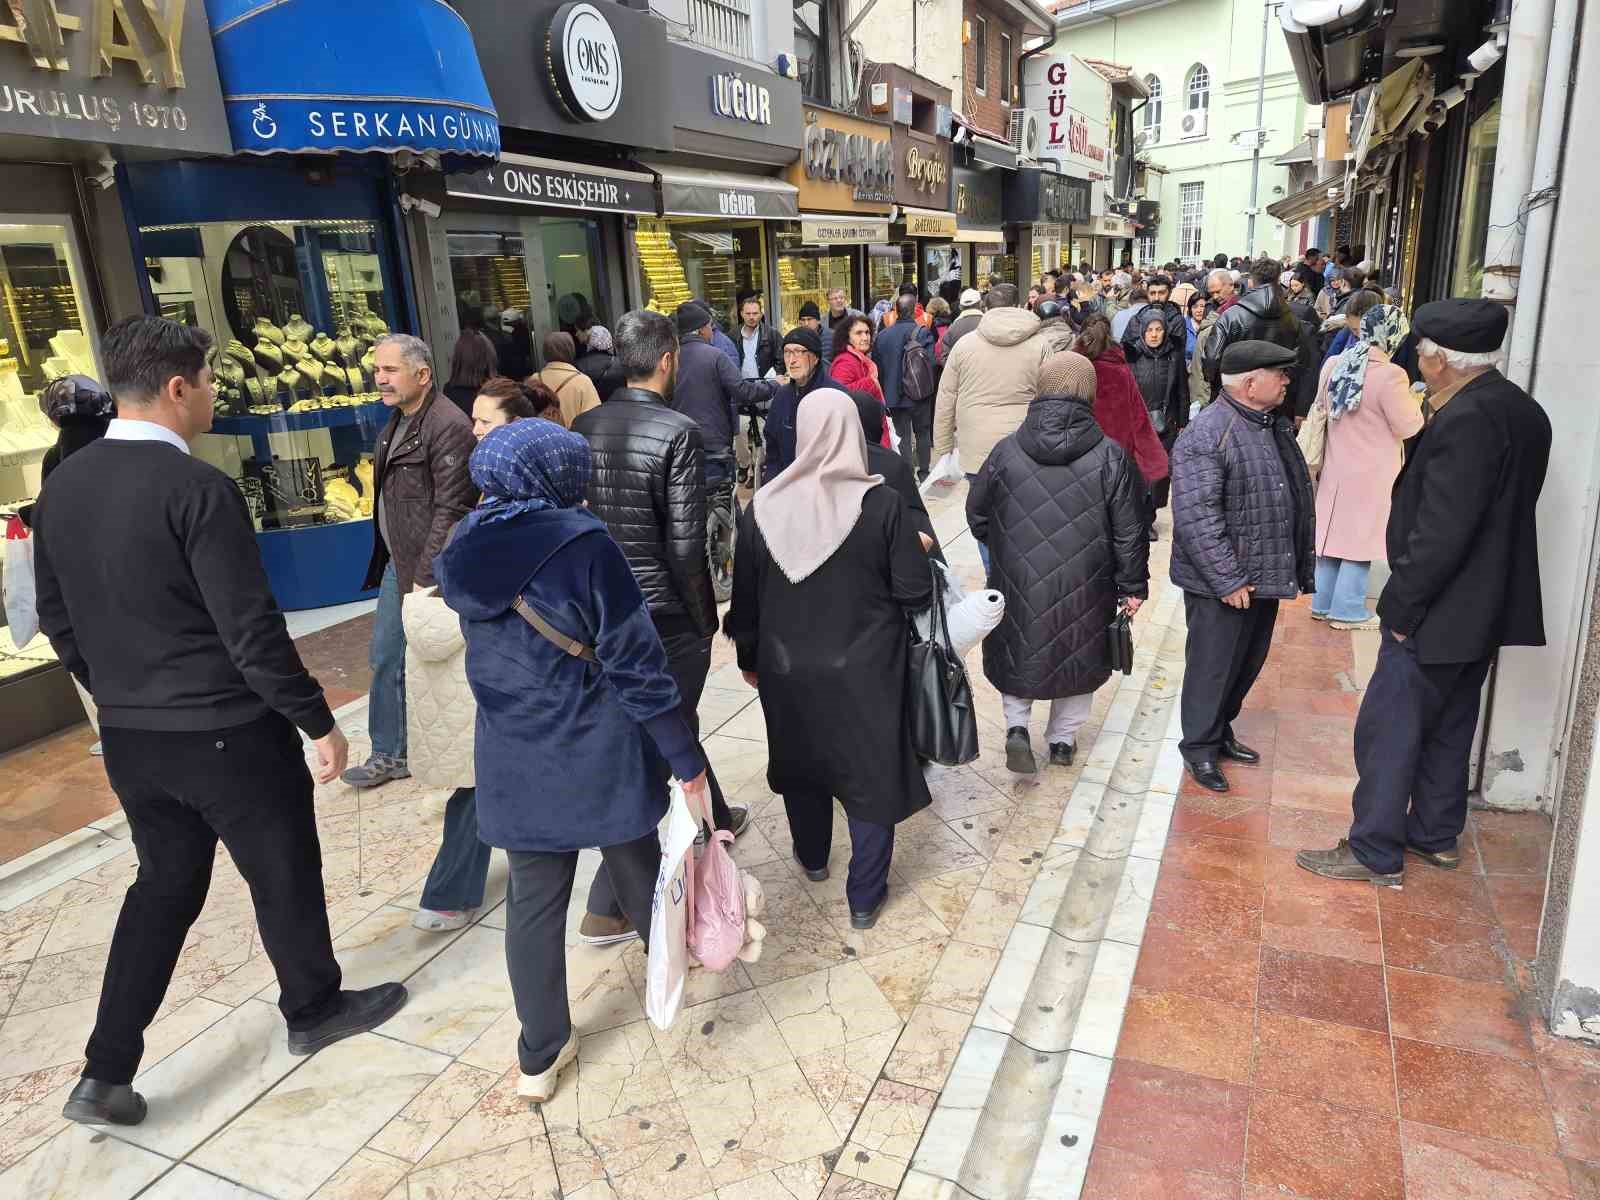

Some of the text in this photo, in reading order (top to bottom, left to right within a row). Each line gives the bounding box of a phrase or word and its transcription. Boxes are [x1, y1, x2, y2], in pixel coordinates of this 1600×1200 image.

[577, 38, 609, 76] ONS
[130, 101, 188, 131] 1970
[713, 72, 771, 125] UĞUR
[1047, 62, 1067, 145] GÜL
[308, 111, 437, 138] SERKAN
[503, 169, 619, 208] ONS ESKİŞEHİR
[718, 188, 757, 216] UĞUR
